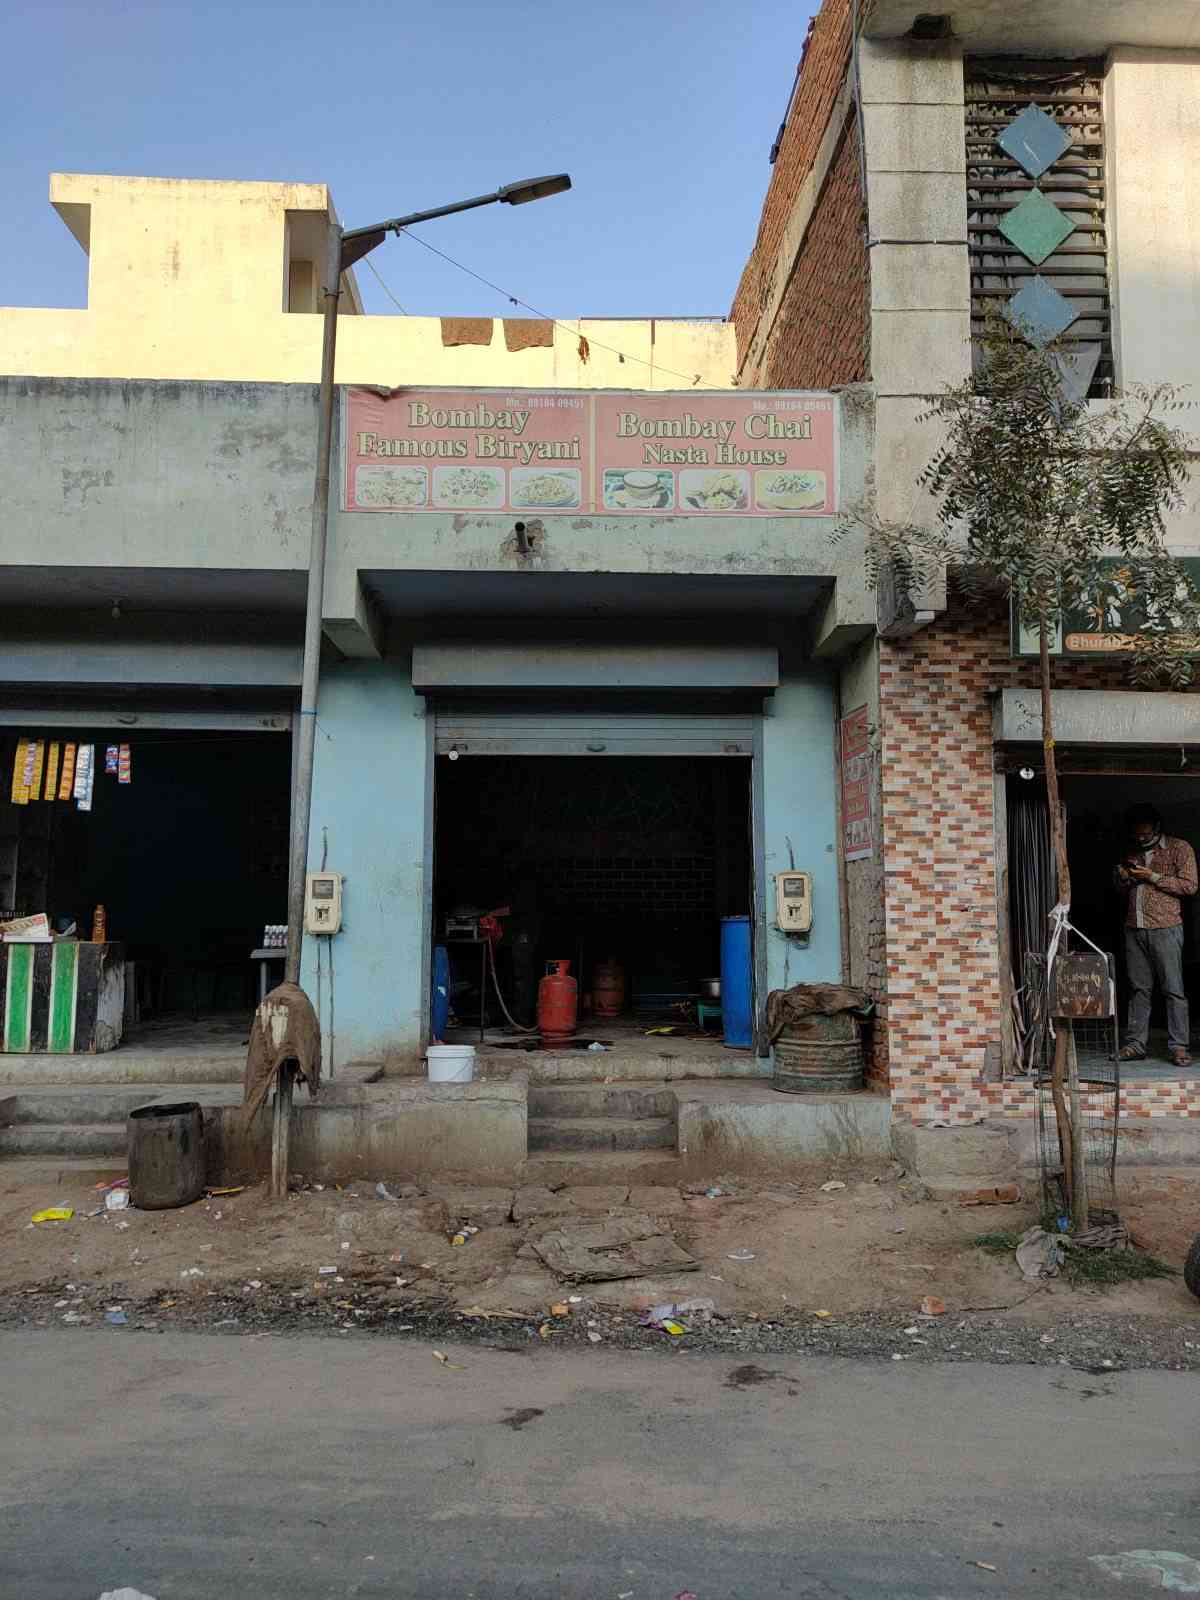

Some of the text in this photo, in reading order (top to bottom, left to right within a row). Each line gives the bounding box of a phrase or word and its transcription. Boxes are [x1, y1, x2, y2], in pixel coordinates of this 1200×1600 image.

[408, 401, 531, 435] Bombay
[616, 411, 813, 444] Bombay Chai
[357, 431, 581, 465] Famous Biryani
[642, 442, 788, 465] Nasta House
